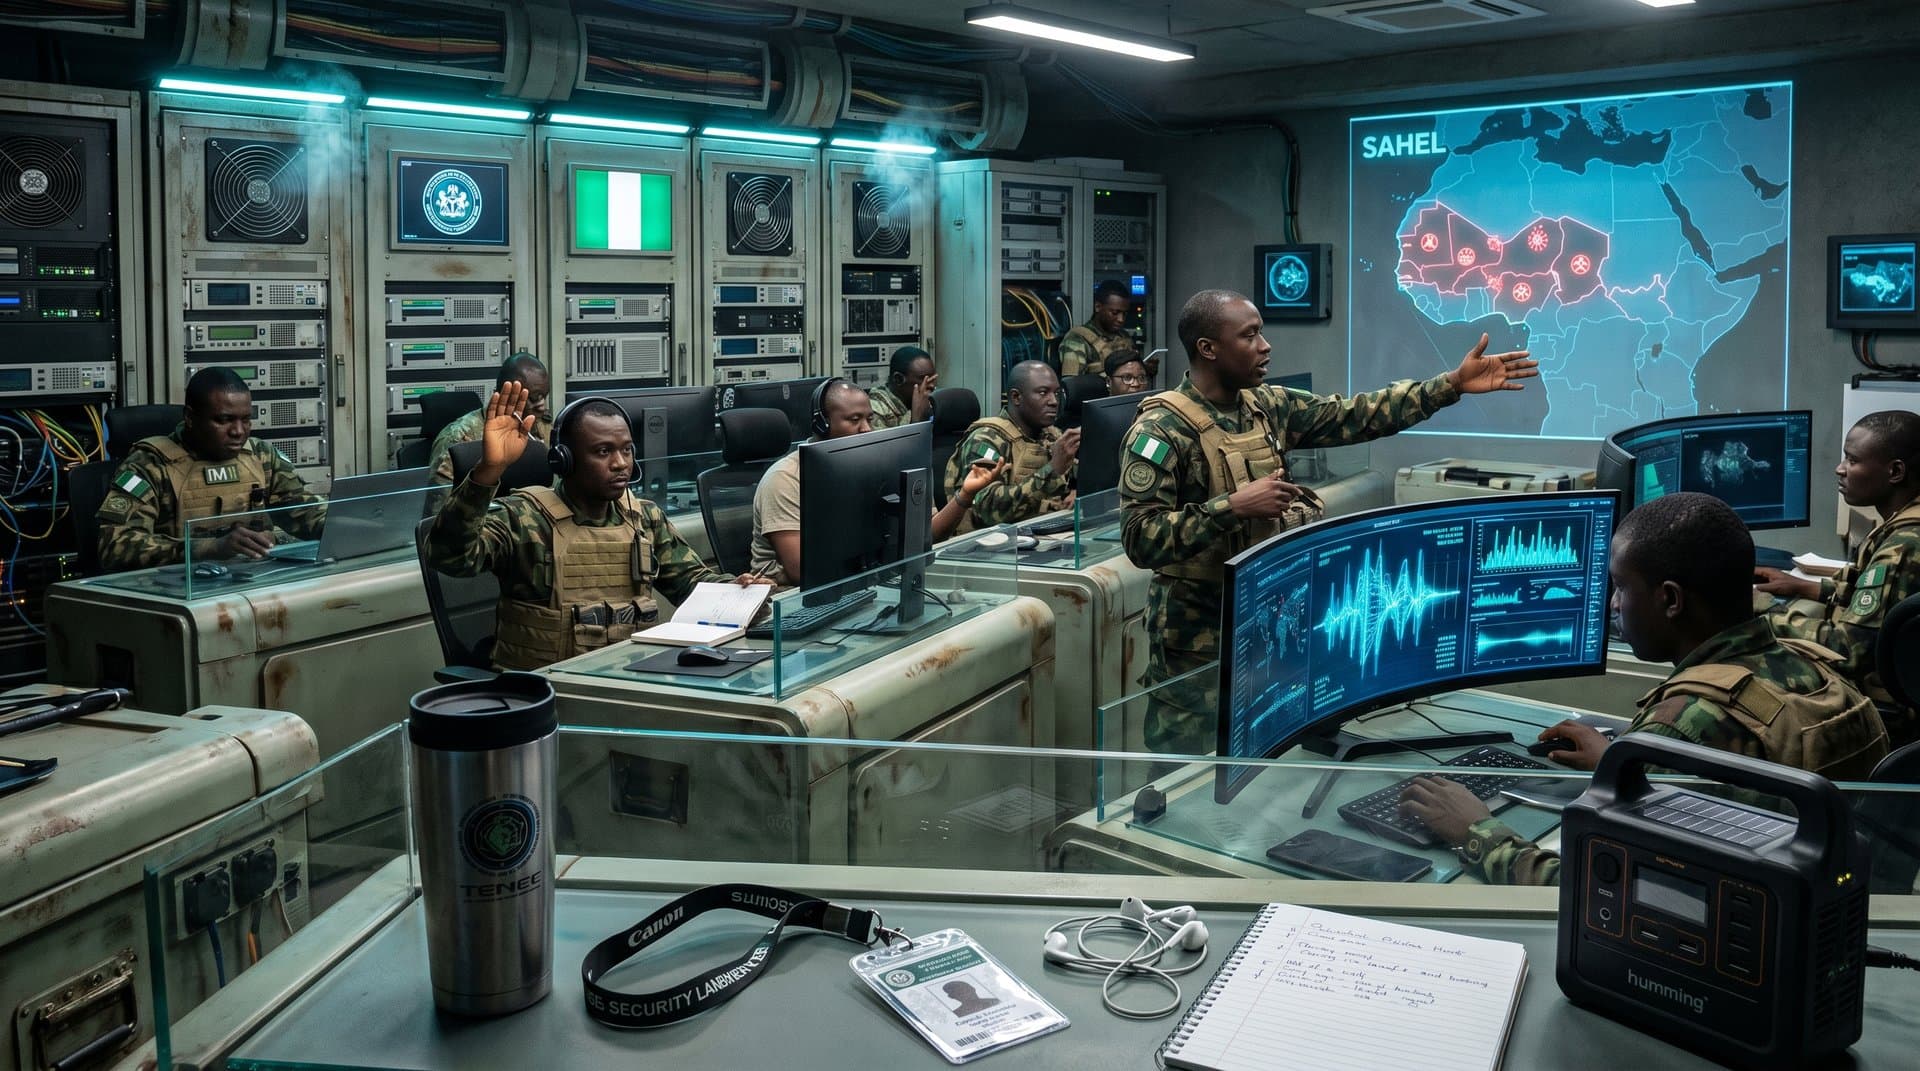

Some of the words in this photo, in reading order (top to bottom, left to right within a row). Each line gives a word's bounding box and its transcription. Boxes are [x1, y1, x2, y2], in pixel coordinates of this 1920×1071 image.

[1362, 131, 1447, 159] SAHEL
[460, 871, 542, 897] TENEE
[628, 906, 684, 947] Canon
[609, 989, 693, 1017] SECURITY
[1627, 968, 1704, 1014] humming
